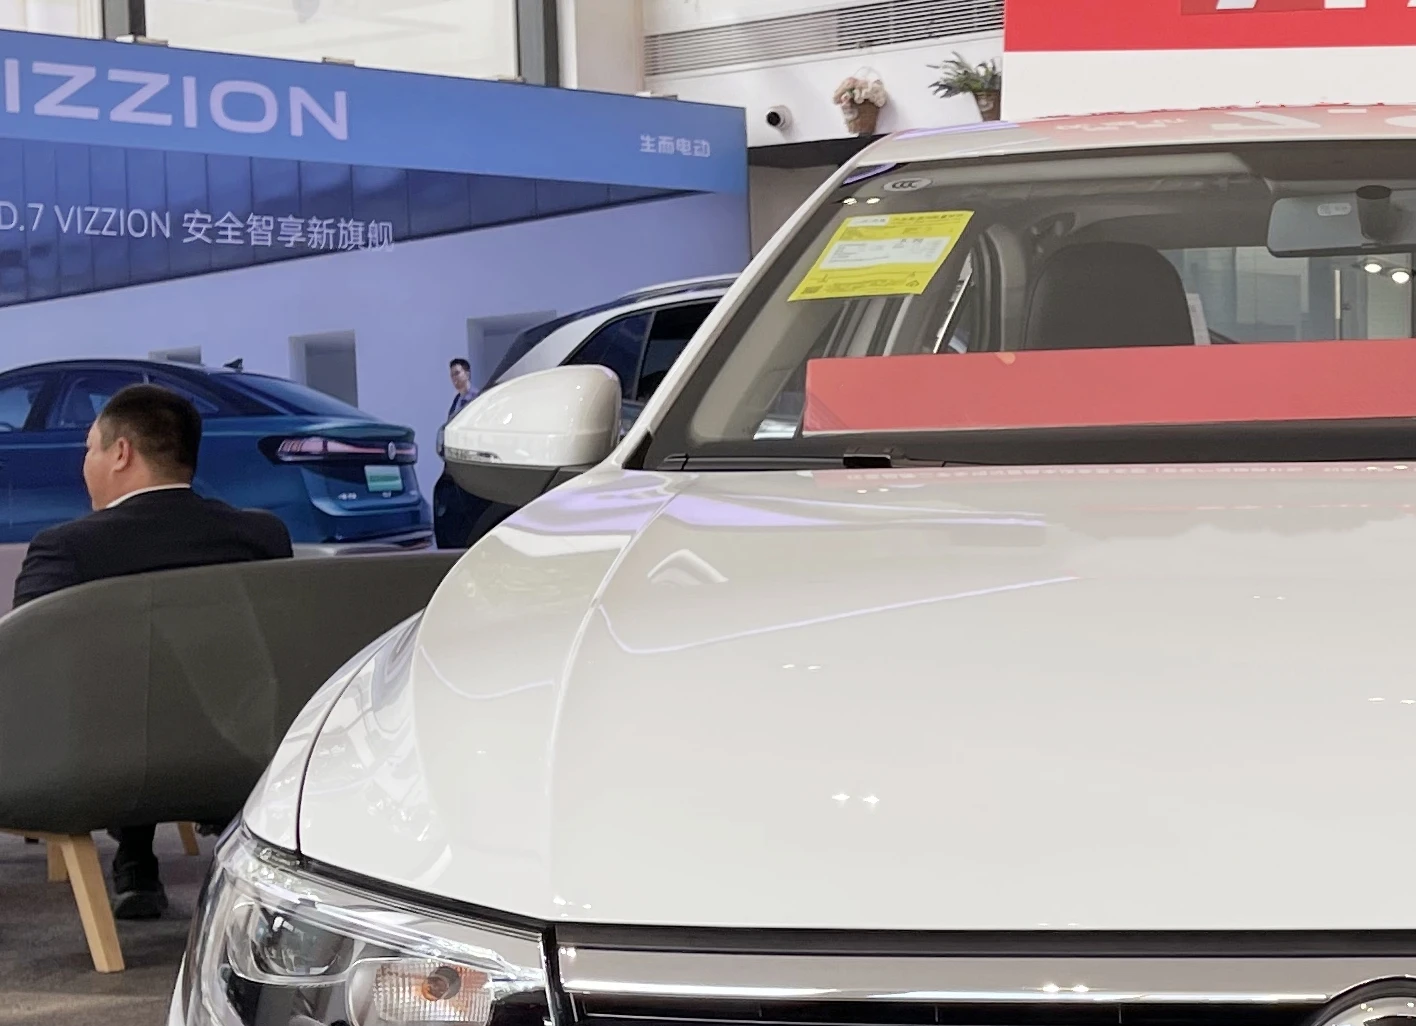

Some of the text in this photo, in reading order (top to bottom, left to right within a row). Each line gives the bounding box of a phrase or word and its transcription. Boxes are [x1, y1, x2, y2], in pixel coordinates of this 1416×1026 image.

[639, 134, 711, 158] 生而电动
[54, 204, 172, 240] VIZZION
[181, 208, 395, 253] 安全智享新旗舰
